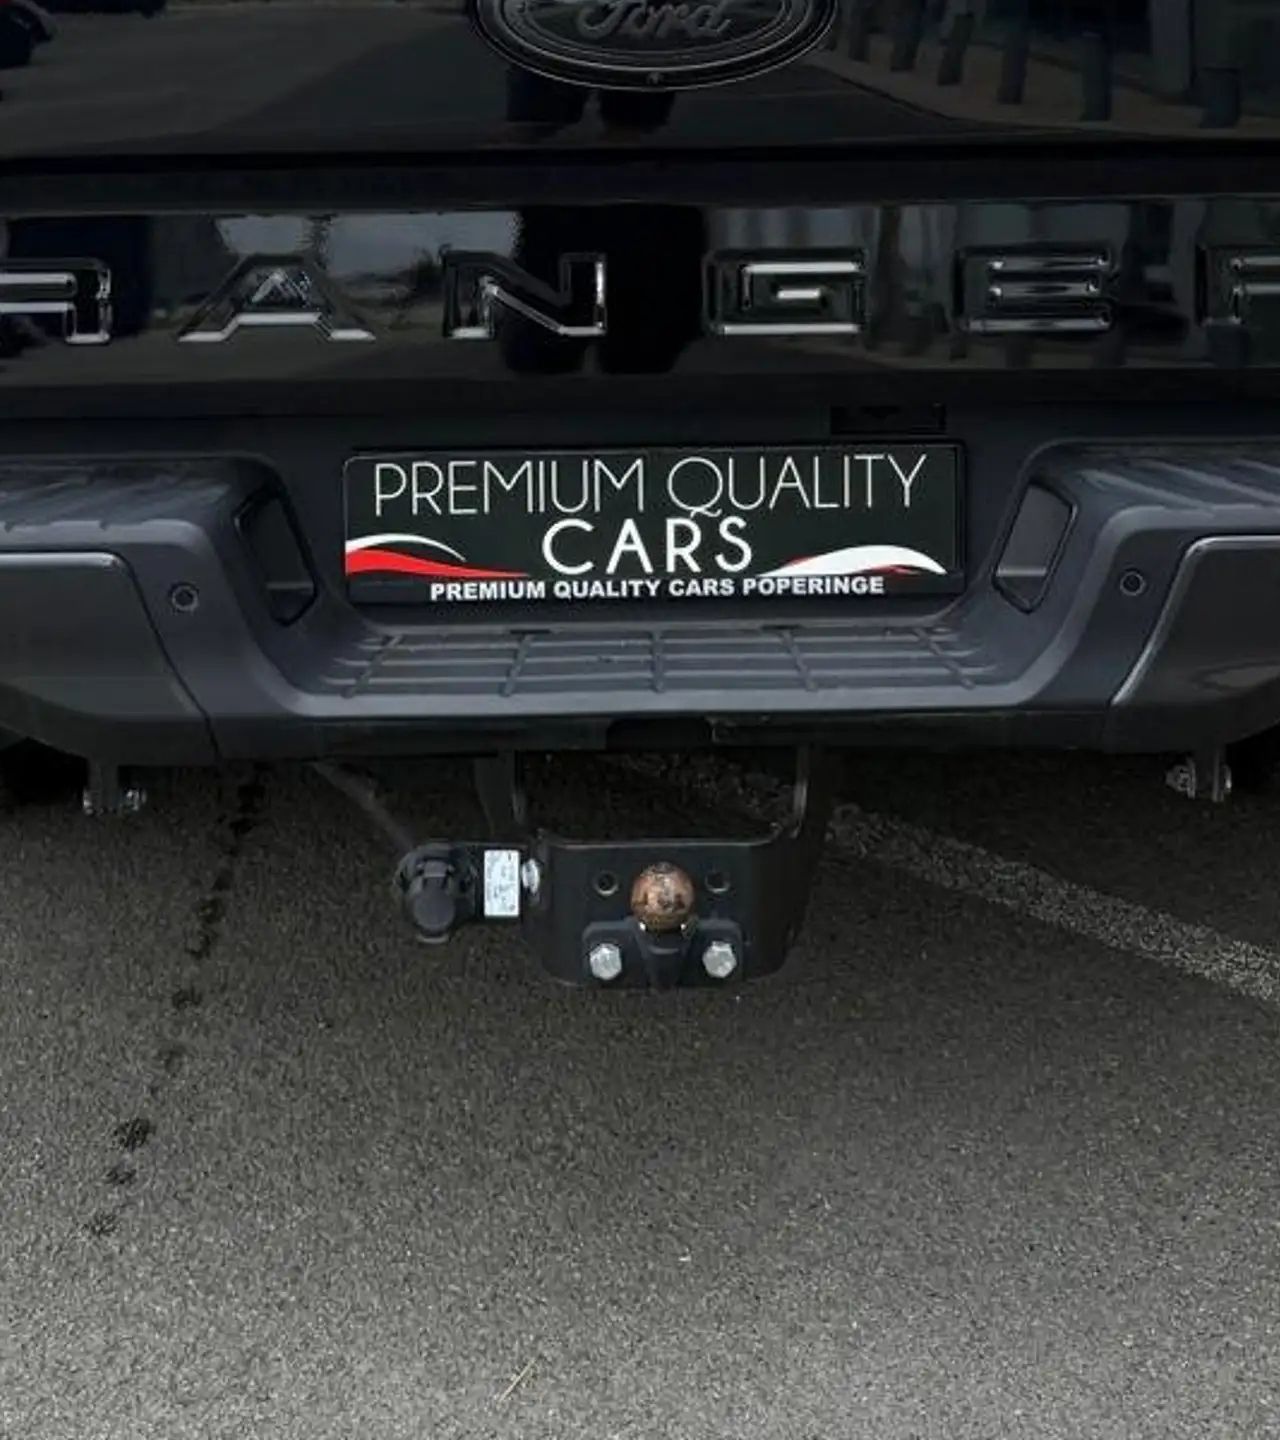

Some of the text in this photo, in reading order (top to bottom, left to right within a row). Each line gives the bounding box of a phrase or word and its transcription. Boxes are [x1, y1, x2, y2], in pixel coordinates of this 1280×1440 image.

[375, 453, 926, 519] PREMIUM QUALITY
[542, 515, 753, 575] CARS
[430, 576, 885, 602] PREMIUM QUALITY CARS POPERINGE
